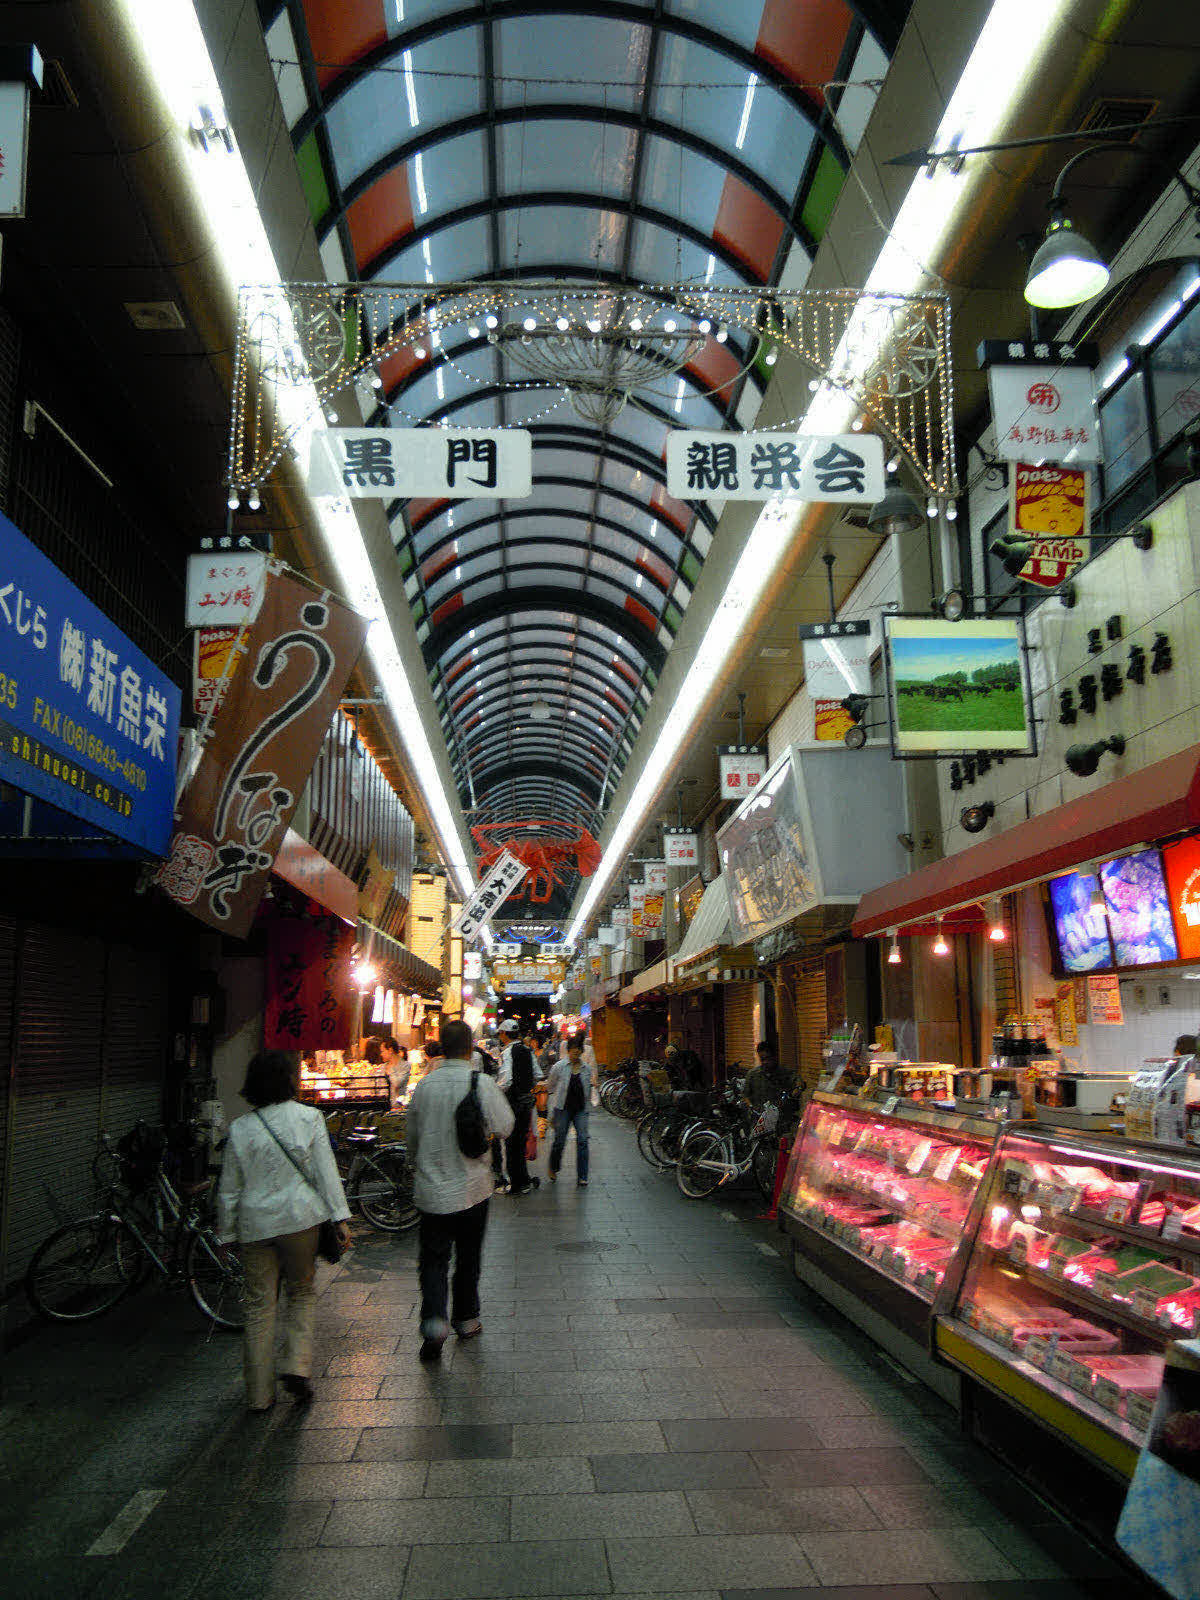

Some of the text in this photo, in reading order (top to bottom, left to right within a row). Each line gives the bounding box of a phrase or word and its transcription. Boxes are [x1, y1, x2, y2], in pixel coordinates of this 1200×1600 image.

[342, 437, 498, 488] 黒門
[687, 442, 867, 494] 親栄会
